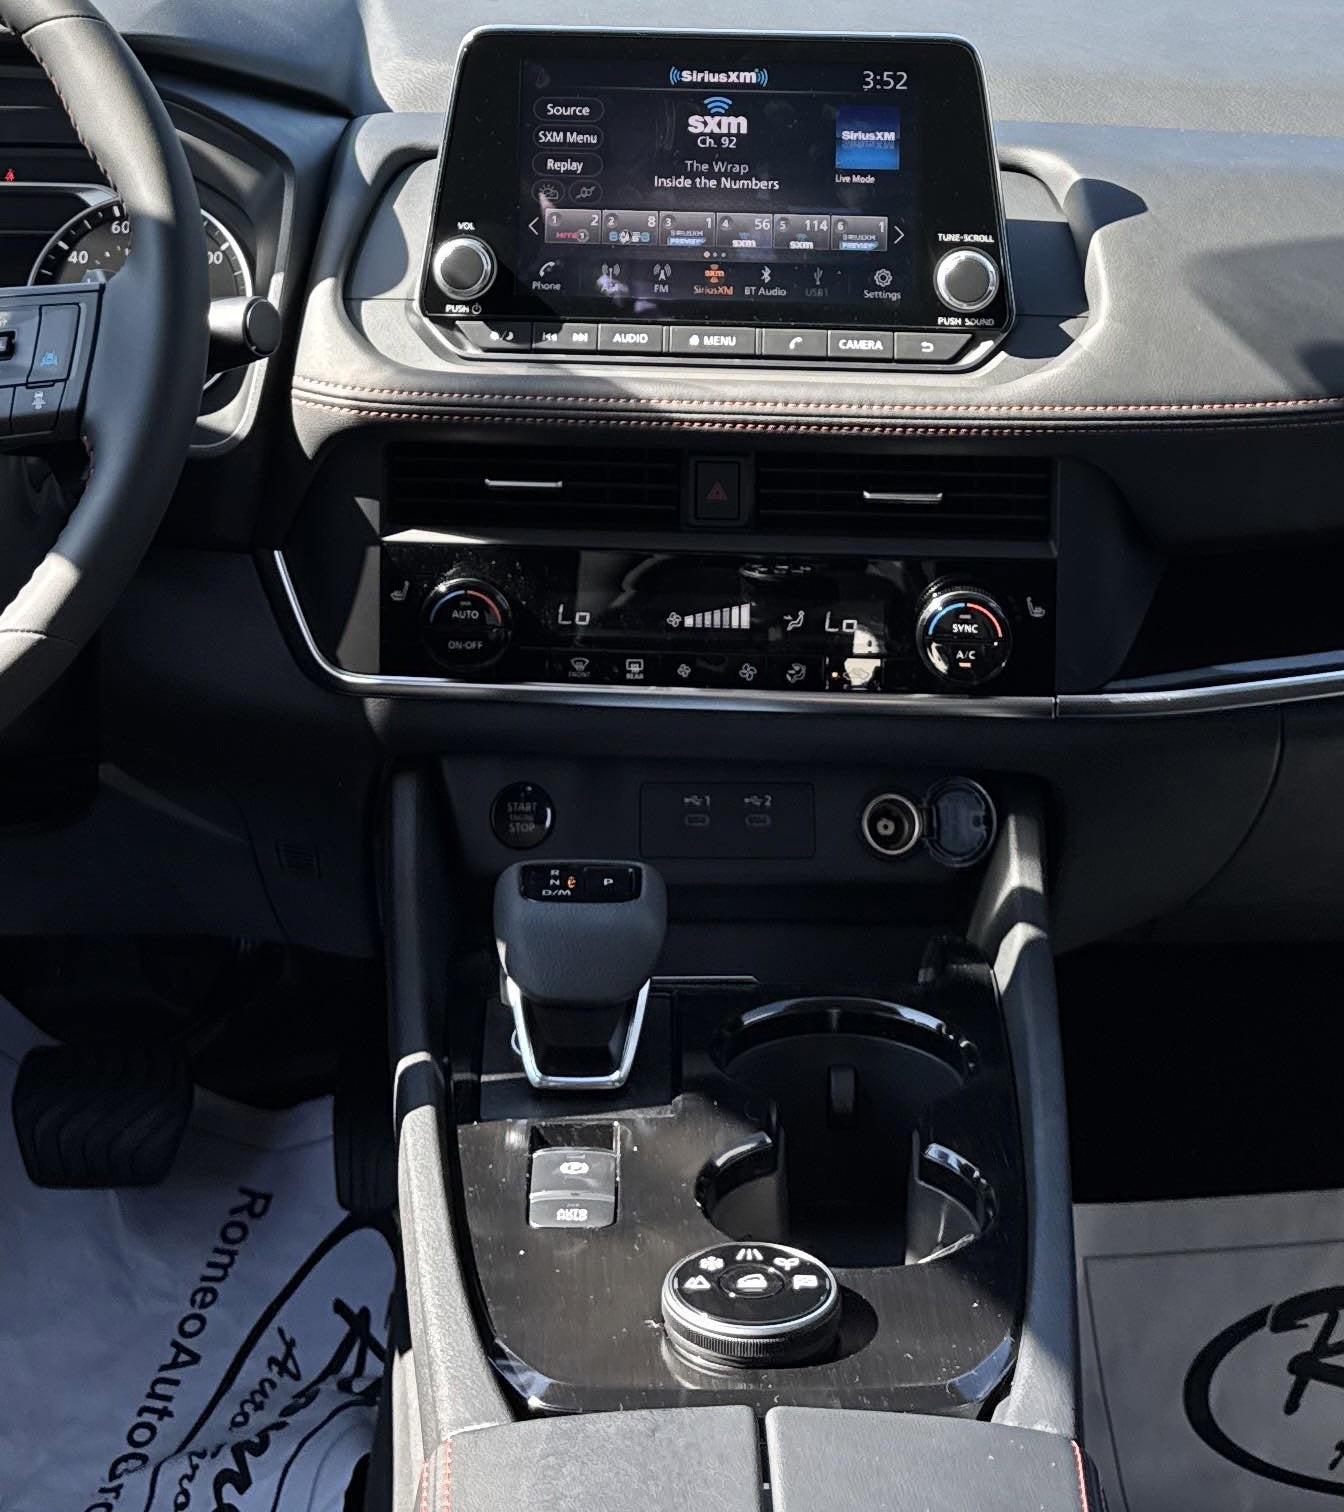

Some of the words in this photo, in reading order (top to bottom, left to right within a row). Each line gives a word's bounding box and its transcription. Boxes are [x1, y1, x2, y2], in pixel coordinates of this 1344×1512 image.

[681, 68, 757, 84] SiriusXM
[862, 71, 908, 90] 3:52
[546, 103, 591, 116] Source
[687, 115, 748, 134] sxm
[538, 131, 564, 143] SXM
[566, 131, 598, 144] Menu
[697, 135, 718, 148] Ch.
[721, 136, 737, 148] 92
[841, 130, 896, 142] SiriusXM
[546, 158, 584, 174] Replay
[685, 160, 711, 173] The
[712, 161, 750, 176] Wrap
[654, 176, 692, 189] Inside
[695, 176, 717, 189] the
[721, 177, 780, 190] Numbers
[852, 175, 876, 184] Mode
[590, 214, 599, 226] 2
[647, 215, 656, 228] 8
[754, 219, 770, 230] 56
[804, 219, 828, 232] 114
[110, 220, 130, 234] 60
[732, 239, 756, 248] sxm
[789, 240, 814, 249] sxm
[67, 250, 89, 264] 40
[531, 281, 561, 291] Phone
[654, 284, 669, 294] FM
[745, 288, 756, 296] BT
[758, 287, 787, 297] Audio
[863, 289, 902, 301] Settings
[937, 317, 962, 326] PUSH
[612, 333, 649, 344] AUDIO
[703, 335, 736, 347] MENU
[838, 339, 884, 350] CAMERA
[451, 609, 480, 620] AUTO
[557, 603, 591, 625] Lo
[824, 610, 858, 633] Lo
[951, 623, 979, 634] SYNC
[447, 640, 484, 650] ON-OFF
[955, 649, 976, 661] A/C
[507, 802, 537, 813] START
[508, 822, 536, 834] STOP
[549, 878, 561, 886] N
[603, 878, 614, 886] P
[541, 888, 572, 896] D/M
[228, 1326, 302, 1432] Auto
